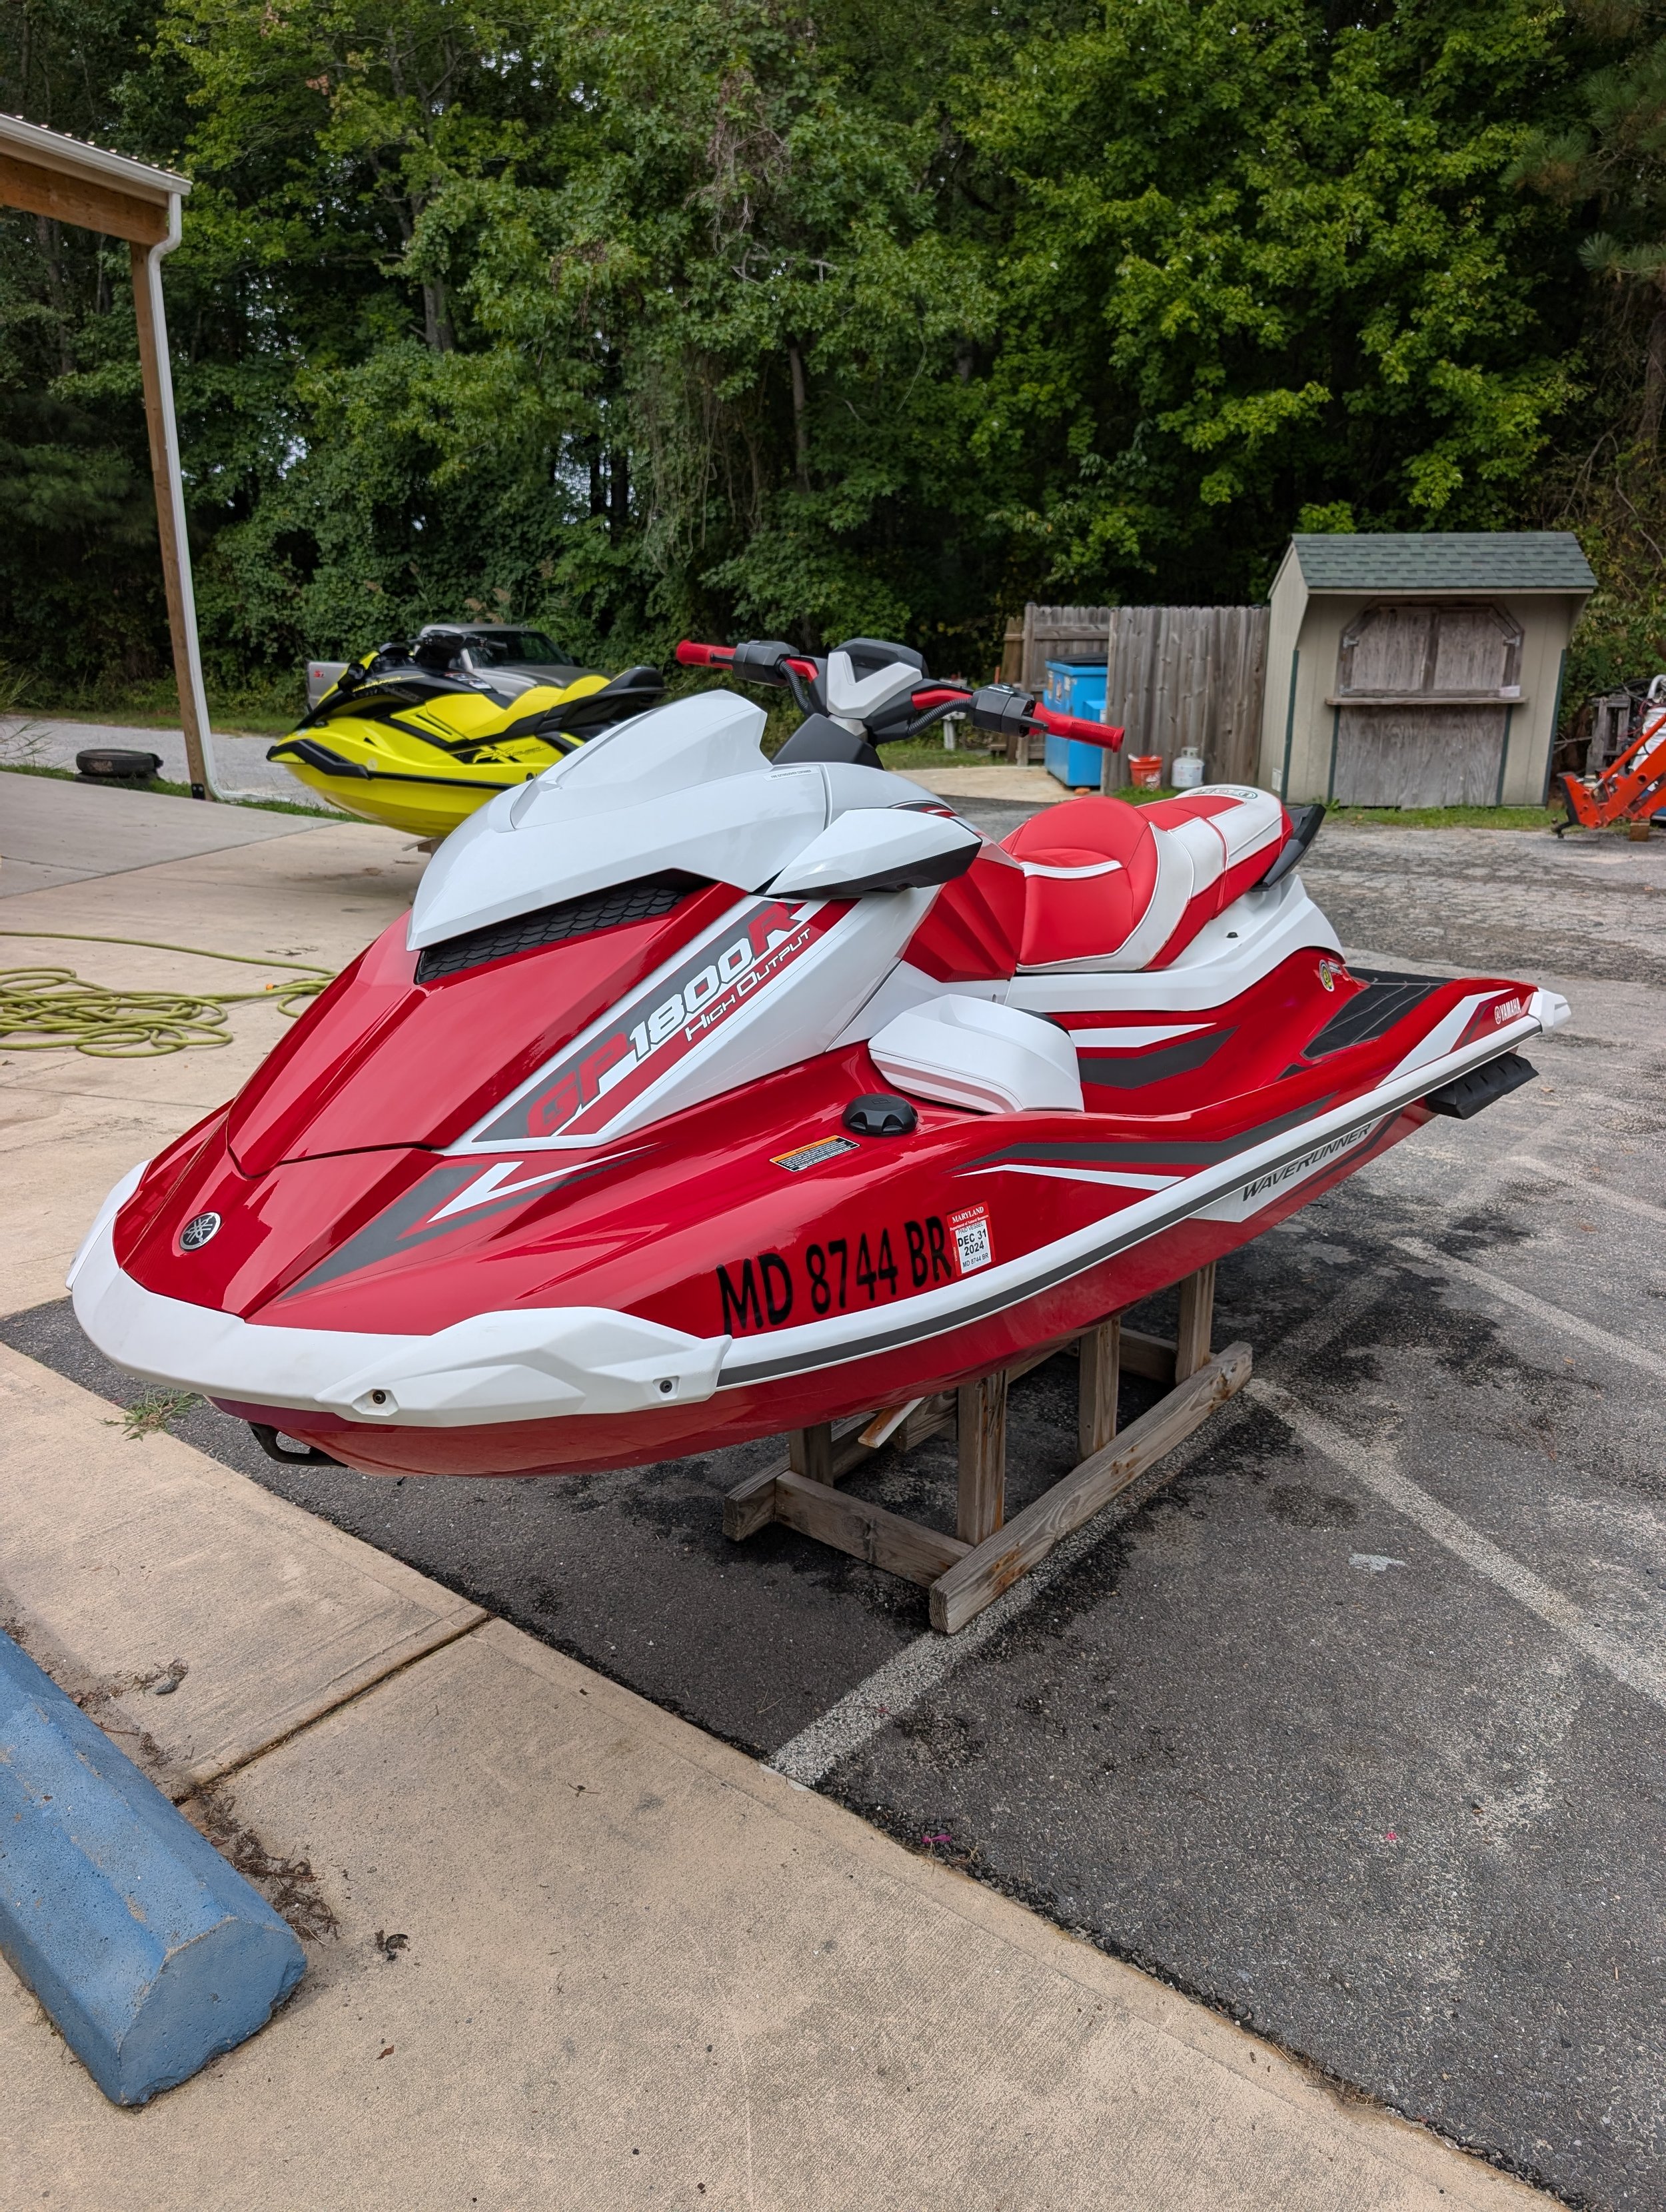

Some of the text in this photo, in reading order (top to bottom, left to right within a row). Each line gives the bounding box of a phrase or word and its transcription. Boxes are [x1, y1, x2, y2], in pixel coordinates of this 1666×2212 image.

[685, 928, 810, 1041] HIGH OUTPUT
[526, 902, 803, 1137] GP1800R
[1499, 997, 1521, 1021] YAMAHA
[1243, 1123, 1371, 1201] WAVERUNNER
[952, 1207, 984, 1224] MARYLAND
[969, 1222, 984, 1231] VESSEL
[958, 1229, 986, 1247] DEC 31
[964, 1241, 984, 1257] 2024
[971, 1255, 982, 1264] 8744
[716, 1216, 952, 1335] MD 8744 BR
